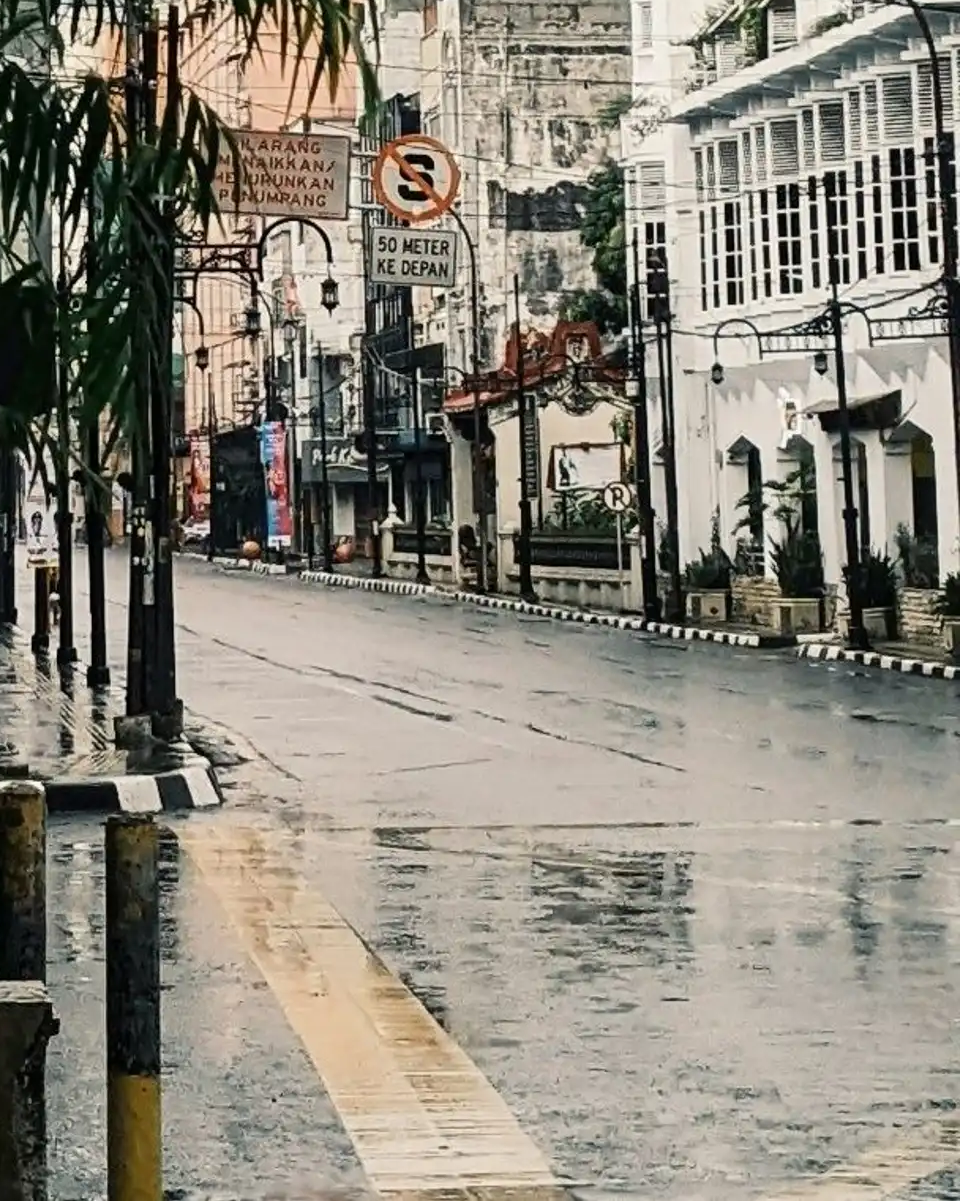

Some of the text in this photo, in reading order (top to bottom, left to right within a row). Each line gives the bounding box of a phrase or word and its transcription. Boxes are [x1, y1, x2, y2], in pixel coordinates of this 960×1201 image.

[235, 137, 322, 155] ILARANG
[219, 154, 337, 173] MNAIKKAN/
[218, 189, 327, 207] PNUMPANG
[377, 236, 451, 256] 50 METER
[377, 258, 450, 278] KE DEPAN
